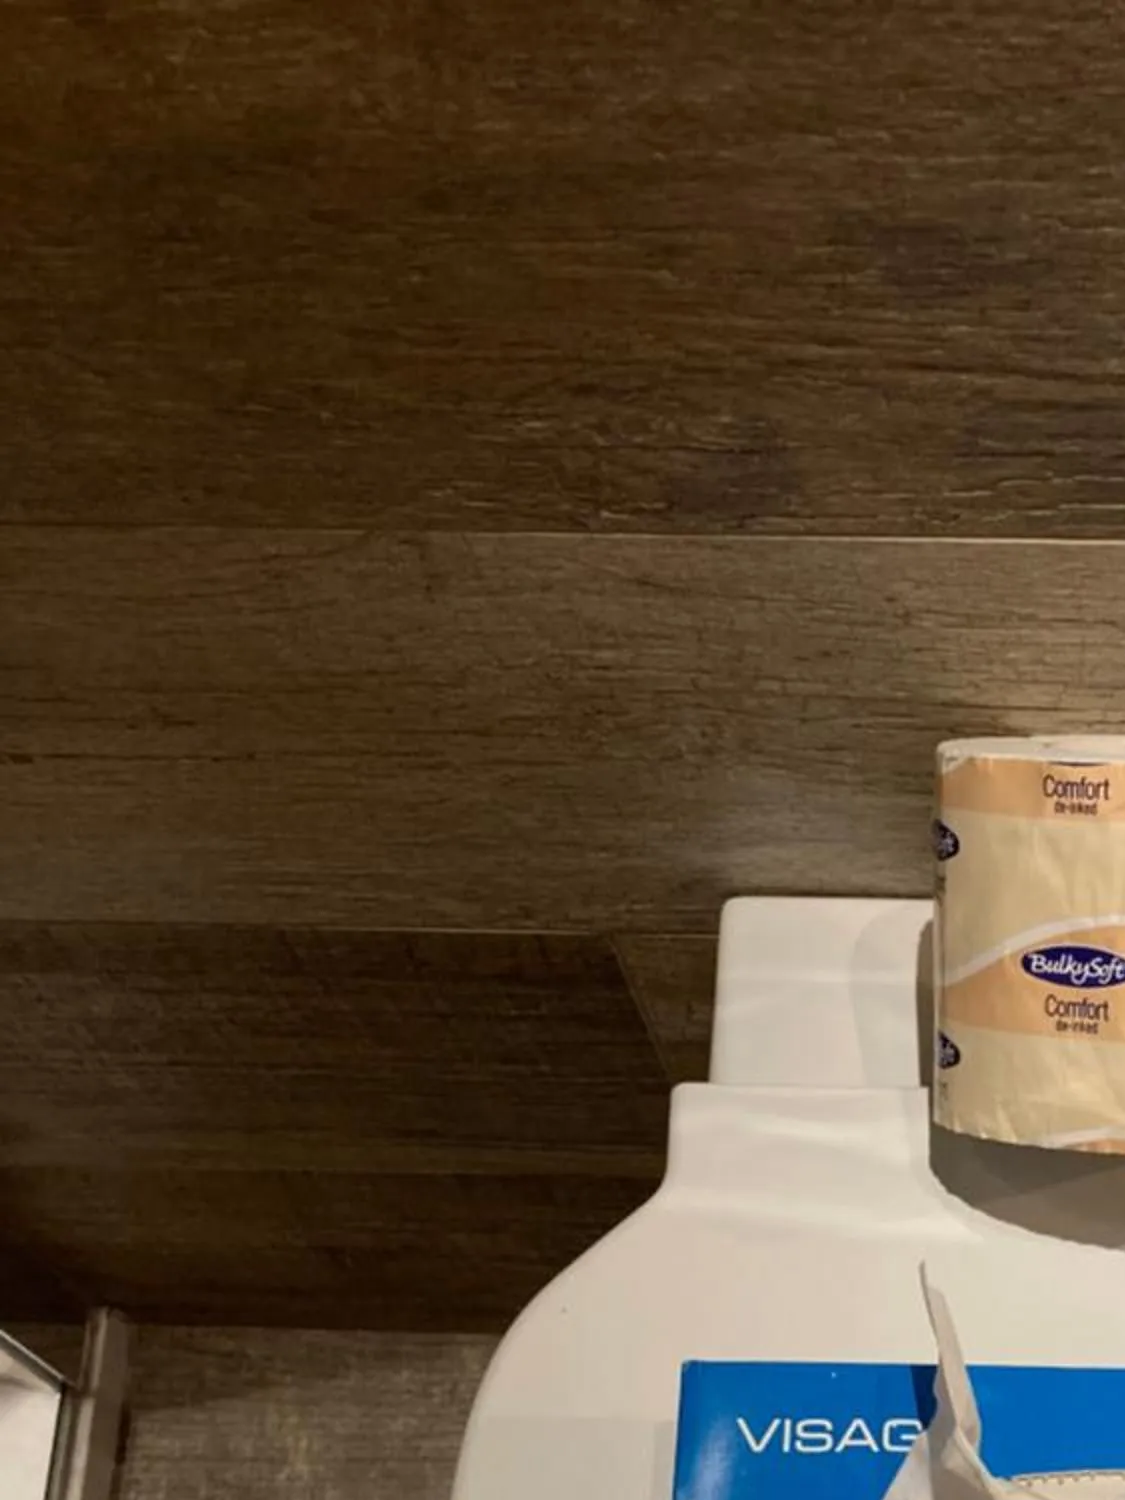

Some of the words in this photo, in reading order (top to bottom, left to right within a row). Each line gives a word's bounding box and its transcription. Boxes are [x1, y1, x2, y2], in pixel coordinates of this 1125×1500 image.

[1042, 774, 1109, 800] Comfort
[1045, 994, 1109, 1021] Comfort
[736, 1417, 923, 1453] VISAG
